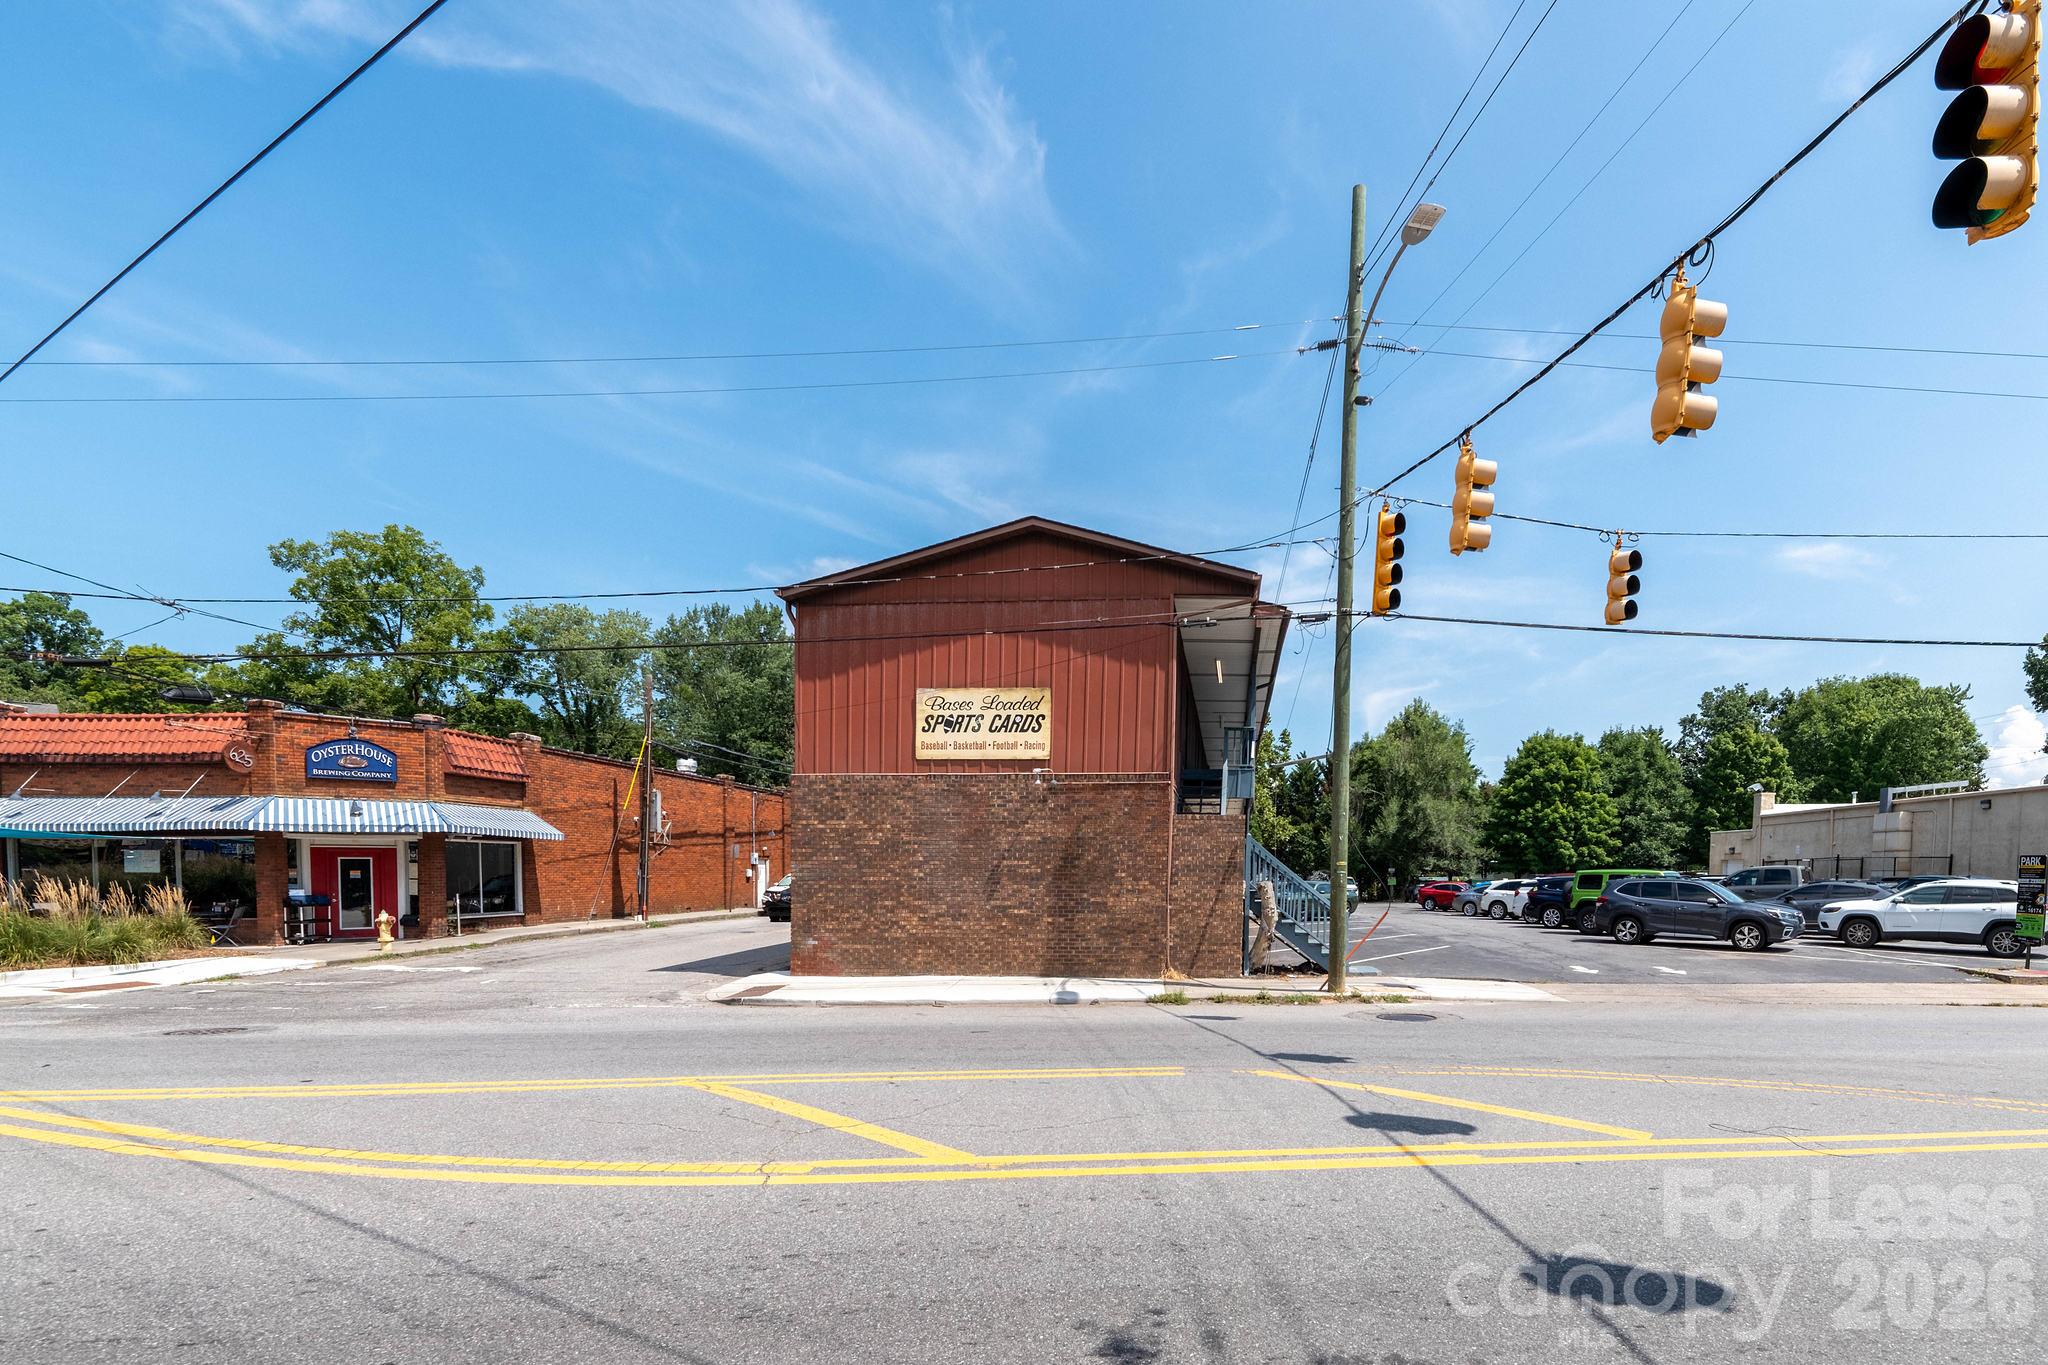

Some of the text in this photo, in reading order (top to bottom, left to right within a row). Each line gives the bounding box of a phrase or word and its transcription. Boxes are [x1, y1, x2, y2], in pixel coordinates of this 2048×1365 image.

[924, 694, 1045, 711] Bases Loaded
[921, 714, 1046, 734] SPORTS CARDS
[920, 740, 1046, 752] Baseball Basketball Football Racing
[229, 746, 253, 768] 625
[2020, 856, 2041, 866] PARK
